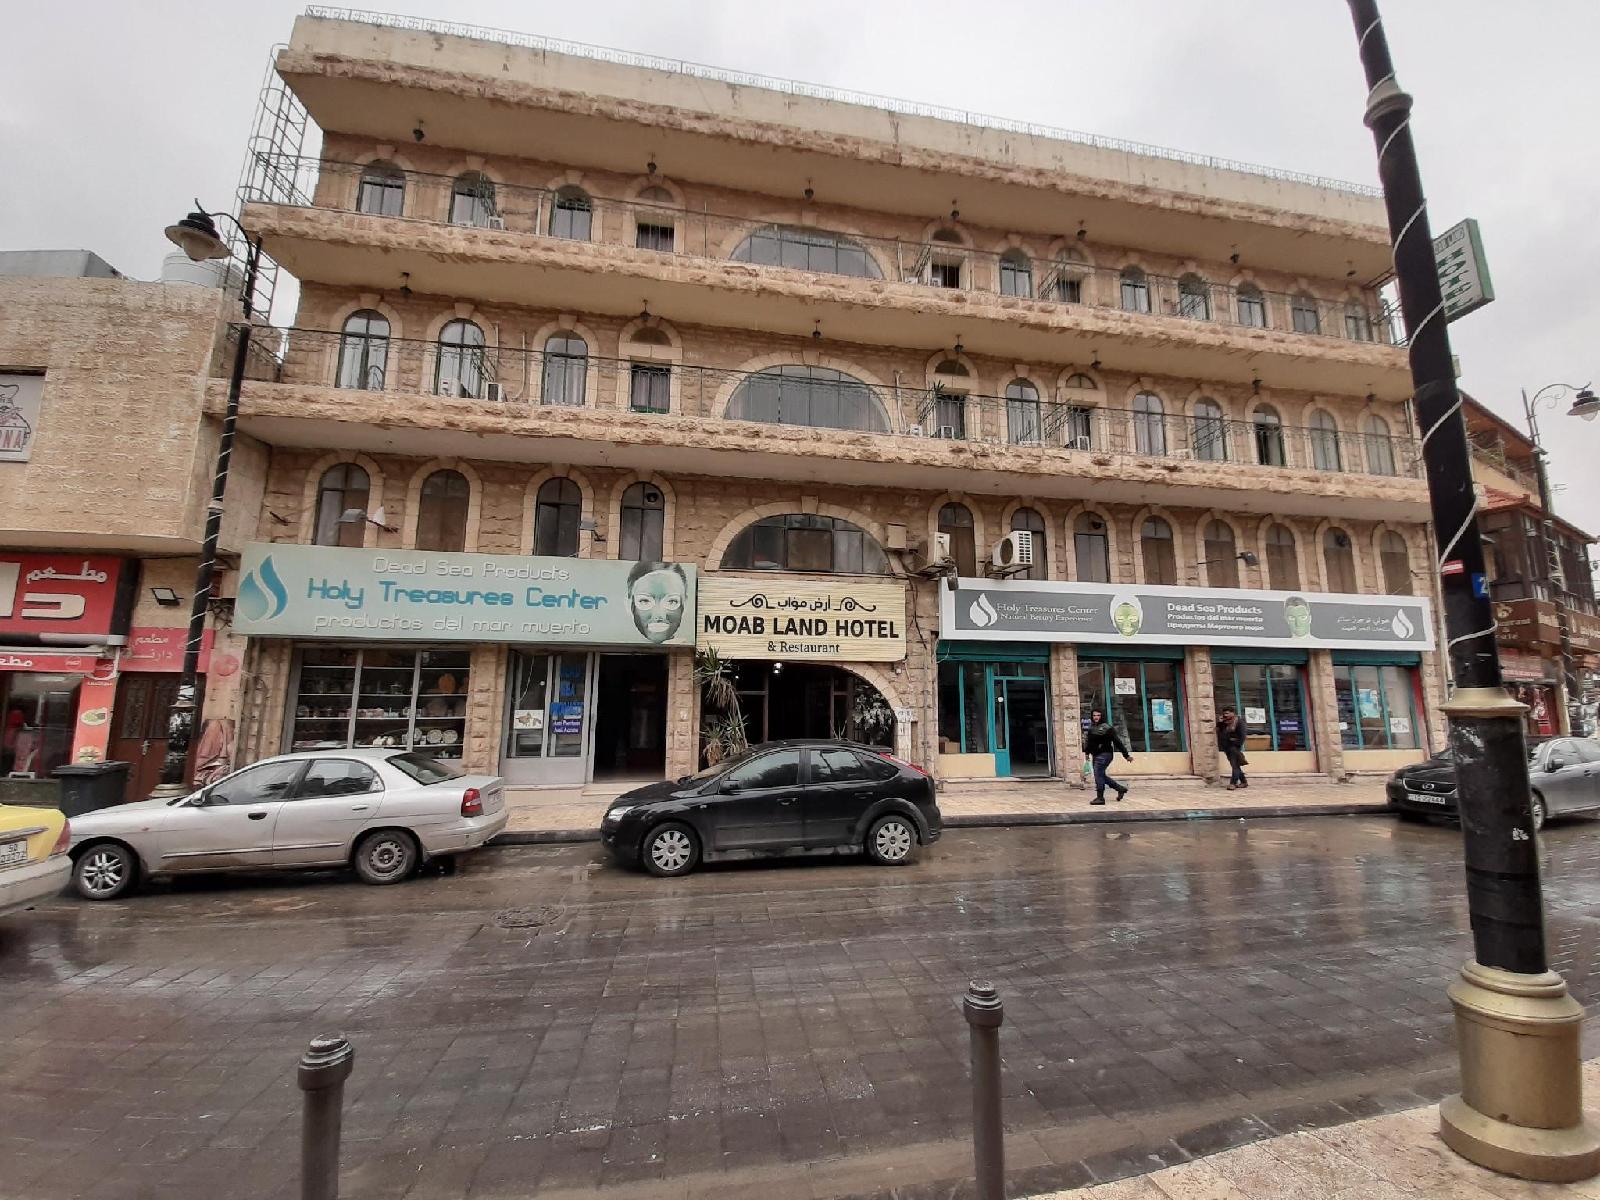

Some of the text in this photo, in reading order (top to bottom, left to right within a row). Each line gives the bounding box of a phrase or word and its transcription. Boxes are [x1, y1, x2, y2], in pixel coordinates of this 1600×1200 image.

[0, 429, 22, 449] NA
[26, 560, 108, 584] مطعم
[373, 556, 571, 581] Dead Sea Products
[306, 577, 609, 611] Holy Treasures Center
[809, 594, 831, 611] أرض
[996, 603, 1099, 615] Holy Treasures Center
[1167, 602, 1263, 614] Dead Sea Products
[314, 614, 592, 635] productos del mar muerto
[704, 615, 900, 639] MOAB LAND HOTEL
[134, 633, 169, 646] مطعم
[767, 641, 840, 653] & Restaurant
[0, 655, 33, 668] مطع
